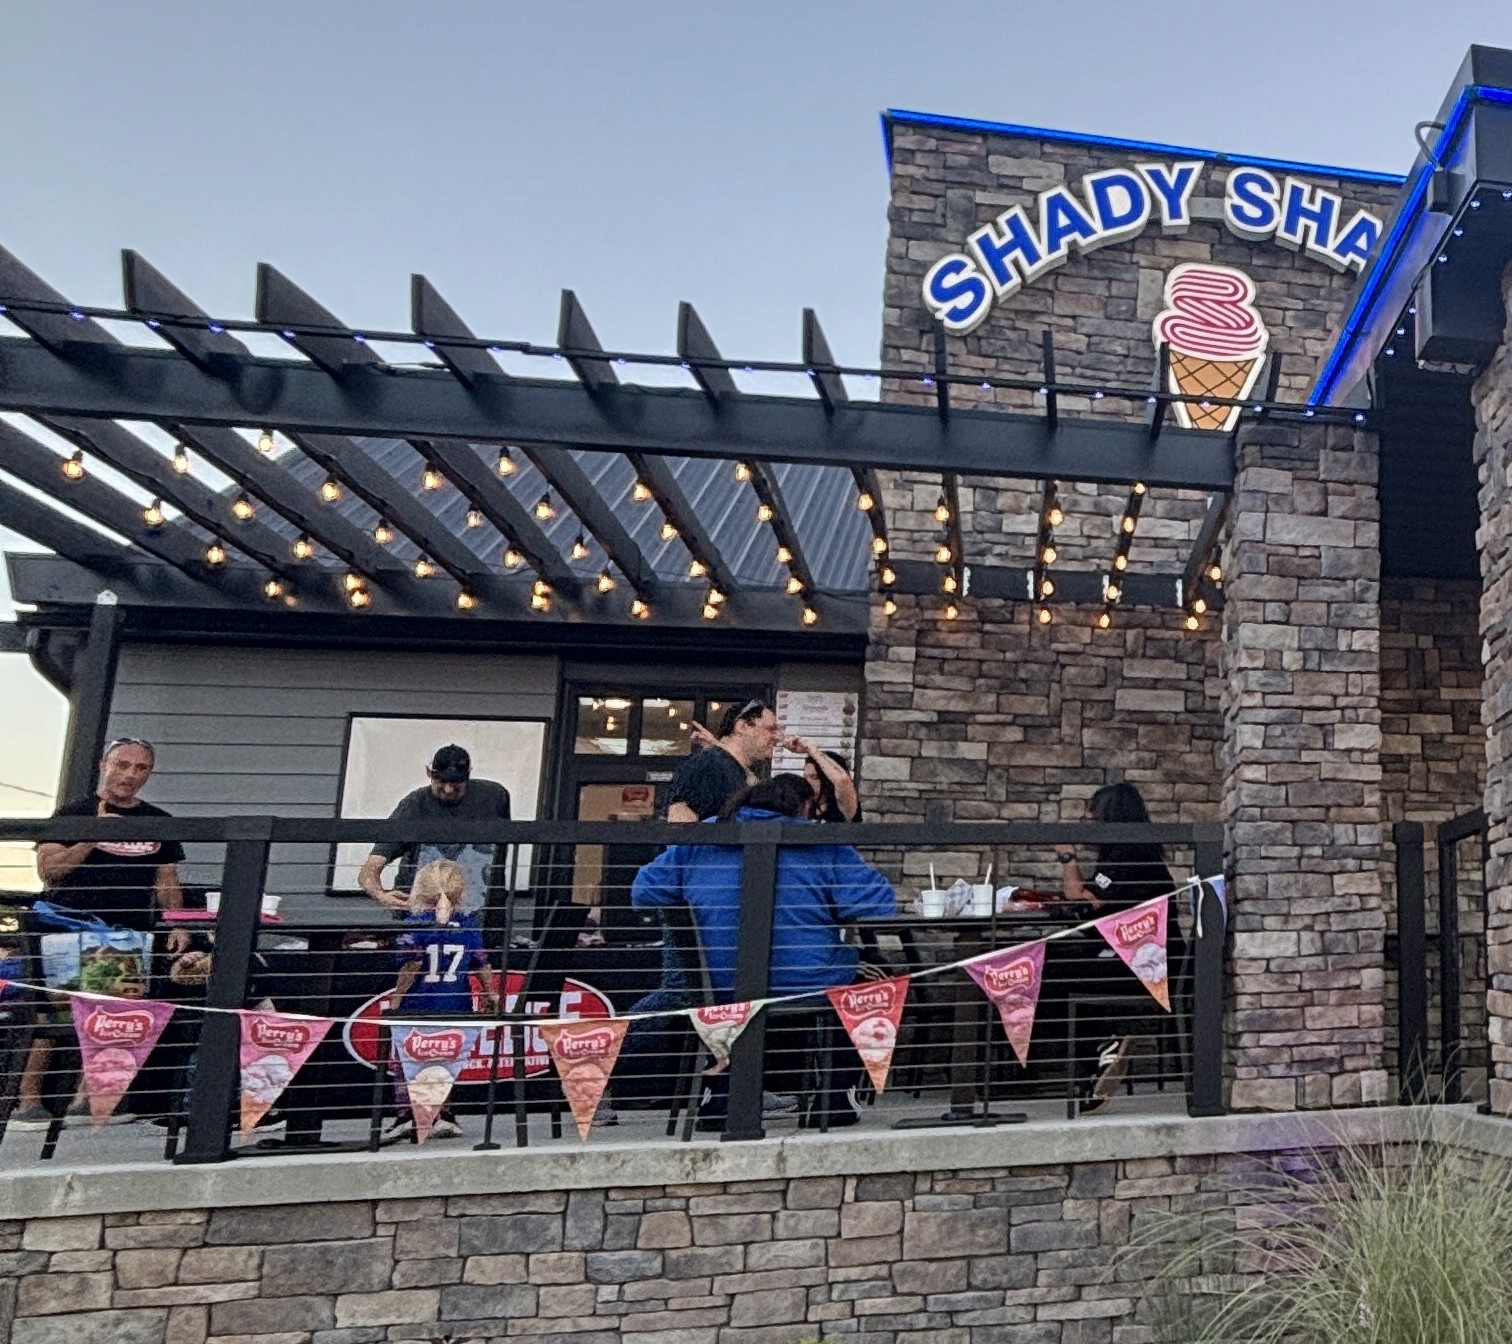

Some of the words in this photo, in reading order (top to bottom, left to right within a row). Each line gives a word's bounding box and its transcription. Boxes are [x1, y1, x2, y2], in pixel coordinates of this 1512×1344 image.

[922, 161, 1205, 329] SHADY
[1225, 167, 1383, 276] SHA
[424, 944, 465, 983] 17
[93, 1014, 144, 1032] Perry's
[256, 1024, 303, 1042] Perry's
[412, 1036, 457, 1052] Perry's
[562, 1036, 606, 1054] Perry's
